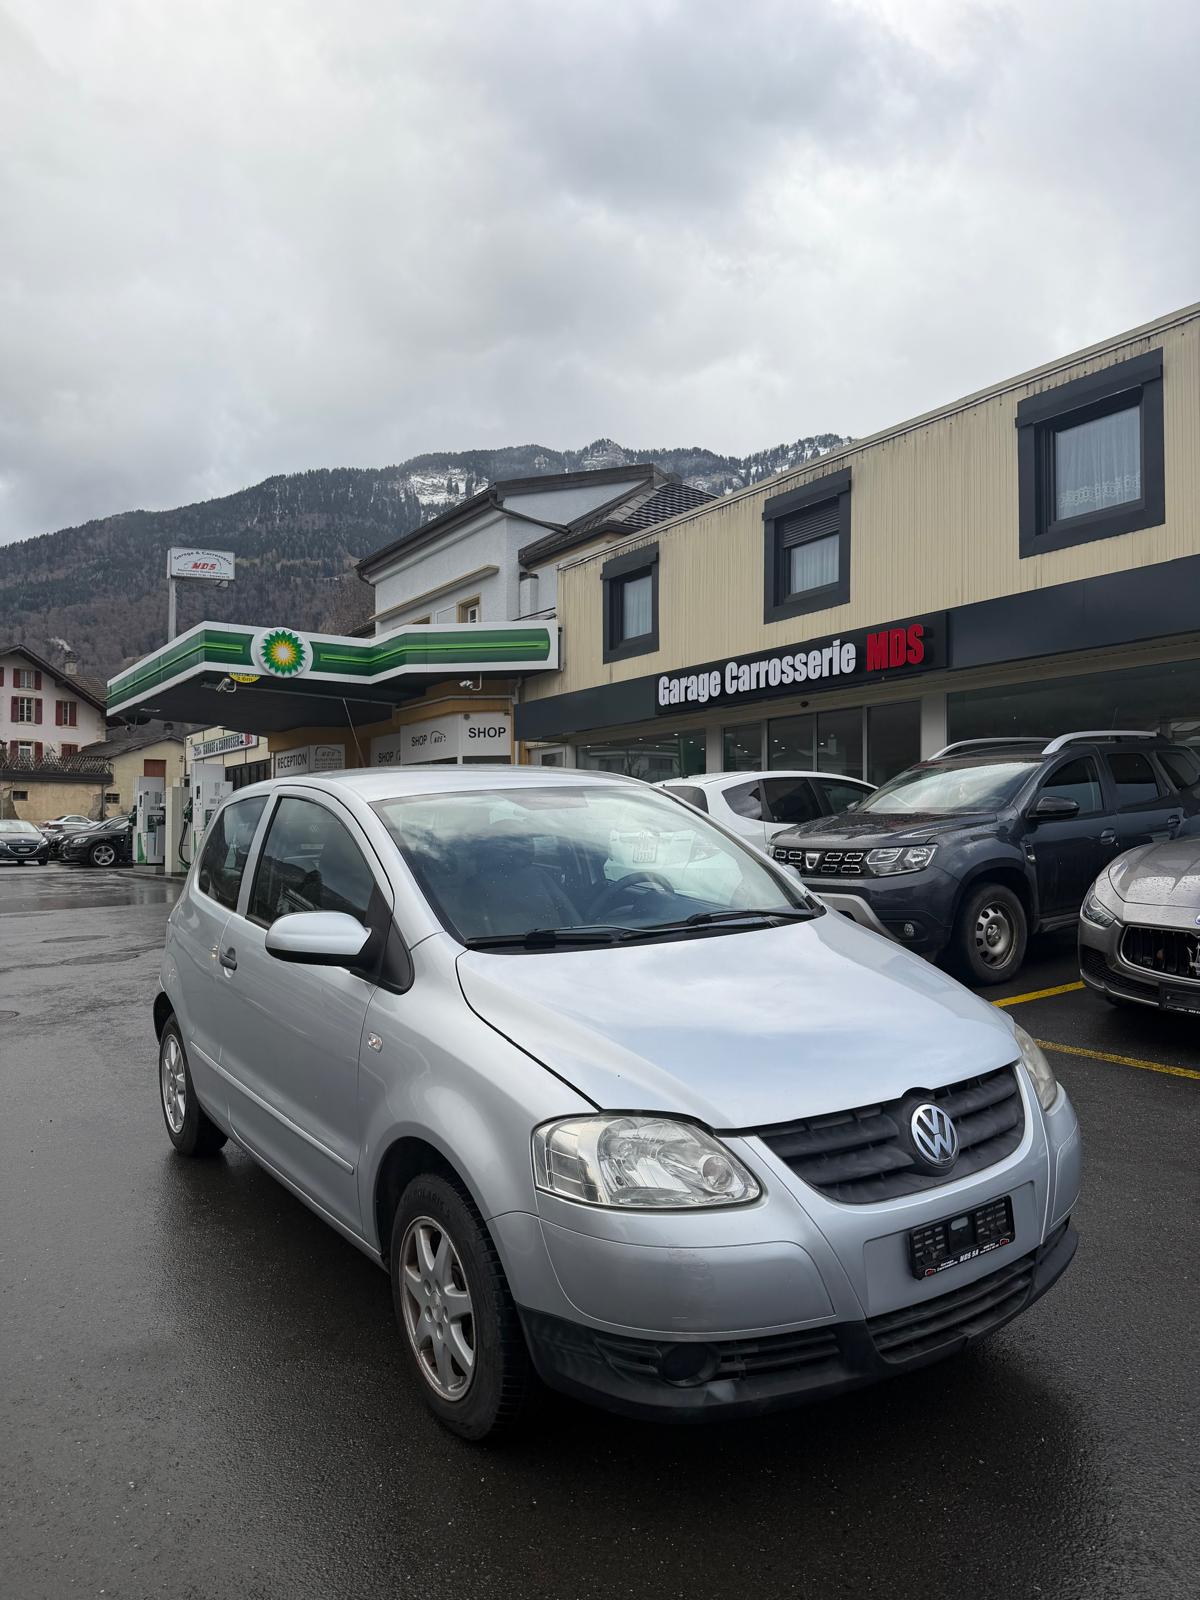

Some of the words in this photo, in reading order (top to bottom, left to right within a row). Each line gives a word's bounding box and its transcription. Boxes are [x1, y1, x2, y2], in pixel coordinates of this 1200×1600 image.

[658, 670, 721, 706] Garage
[725, 639, 856, 695] Carrosserie
[866, 623, 924, 672] MDS
[468, 727, 506, 739] SHOP
[411, 735, 428, 747] SHOP
[277, 753, 307, 769] RECEPTION
[378, 751, 393, 763] SHOP
